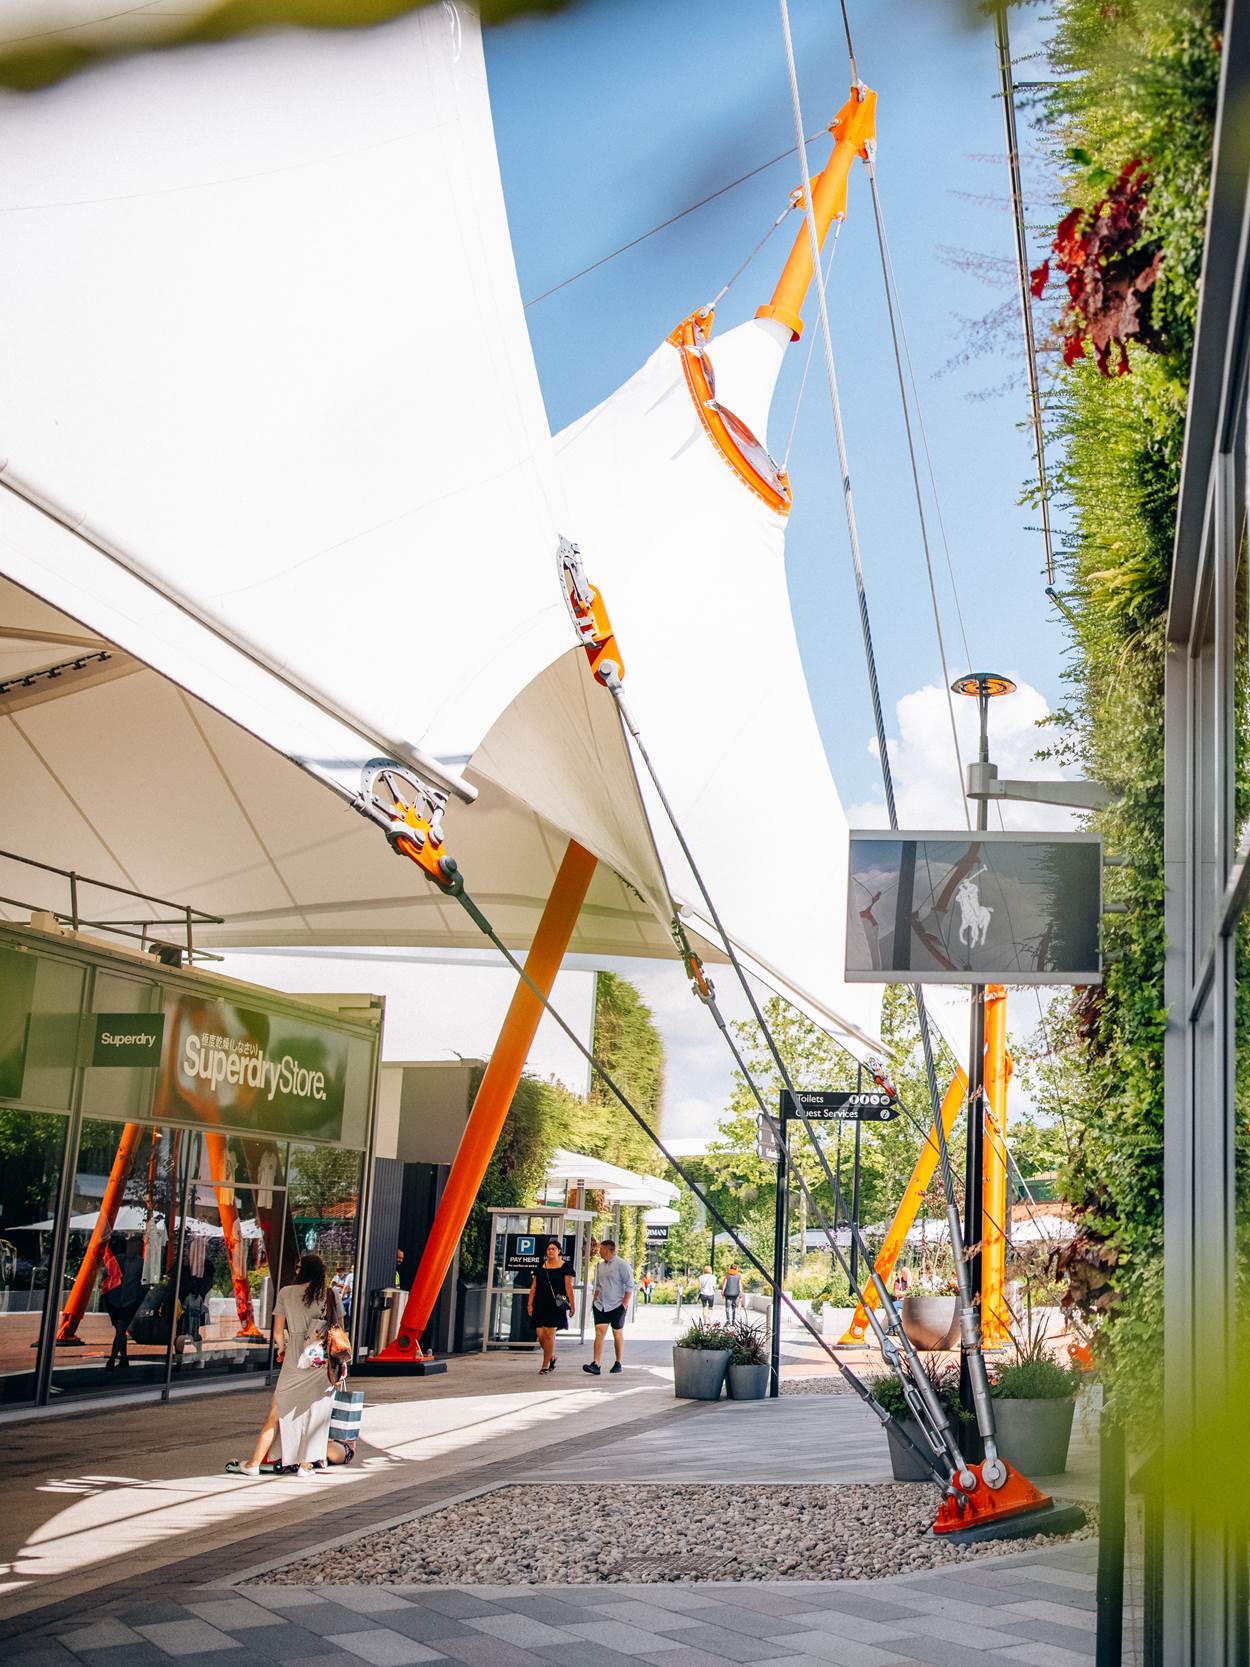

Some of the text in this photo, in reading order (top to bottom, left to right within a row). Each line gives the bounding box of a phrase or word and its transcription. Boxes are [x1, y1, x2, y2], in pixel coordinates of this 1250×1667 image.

[101, 1032, 156, 1047] Superdry
[797, 1094, 824, 1104] Toilets
[823, 1110, 858, 1118] Services
